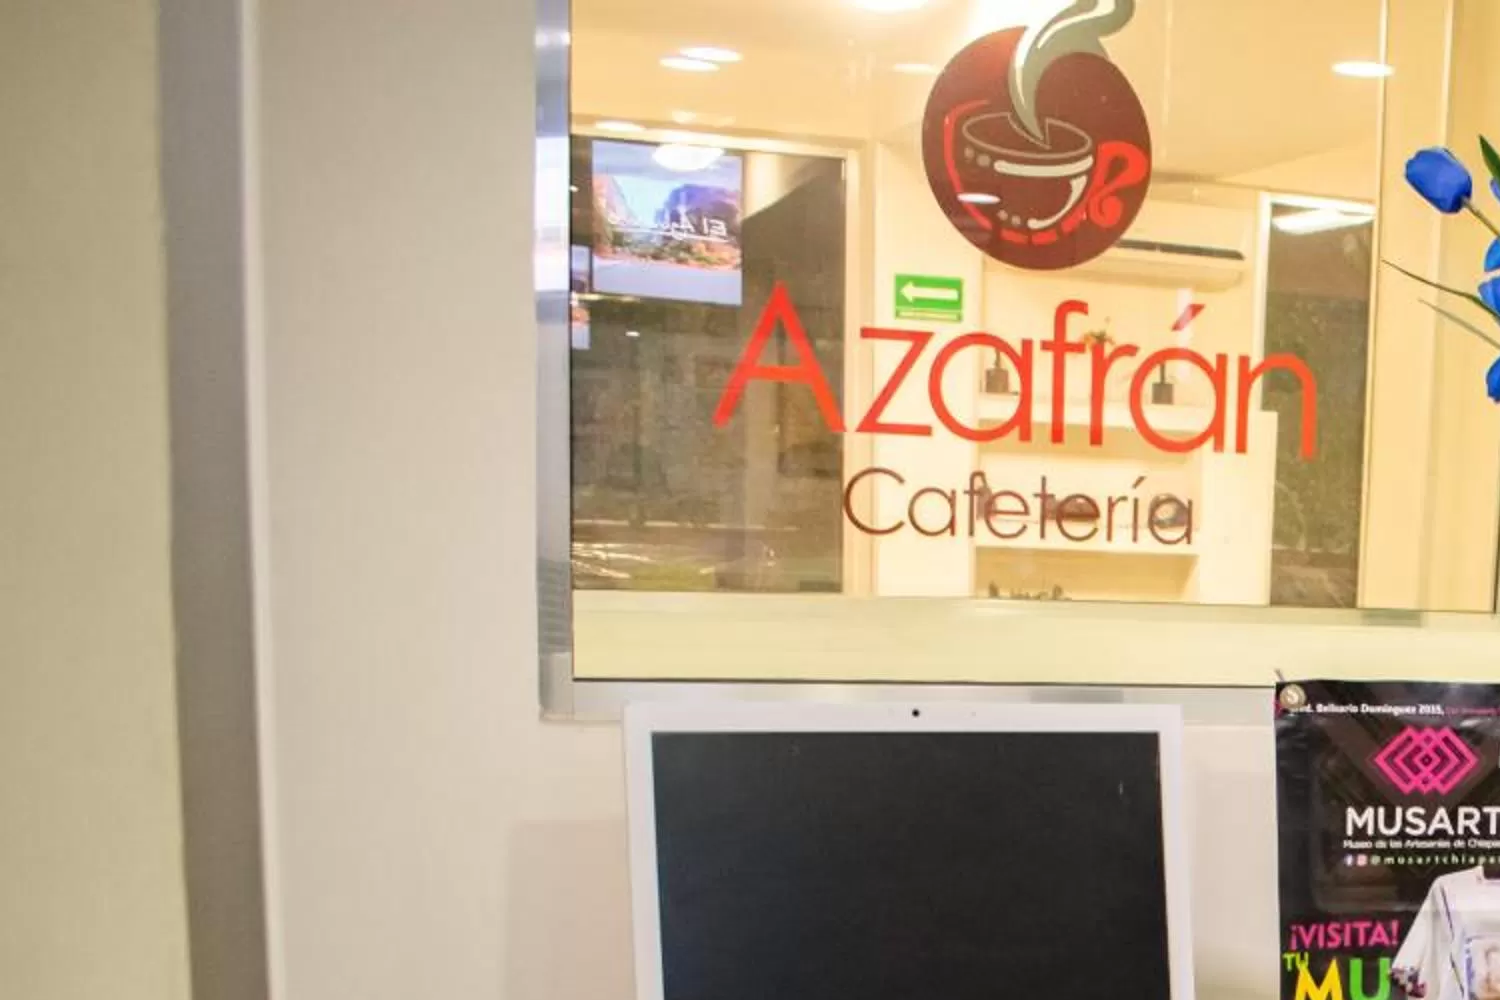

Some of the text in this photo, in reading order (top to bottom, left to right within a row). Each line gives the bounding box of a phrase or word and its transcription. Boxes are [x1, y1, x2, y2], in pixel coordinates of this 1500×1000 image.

[713, 281, 1316, 460] Azafrán
[842, 467, 1193, 546] Cafetería
[1453, 839, 1465, 849] de
[1289, 920, 1400, 951] ¡VISITA!
[1282, 952, 1310, 972] TU
